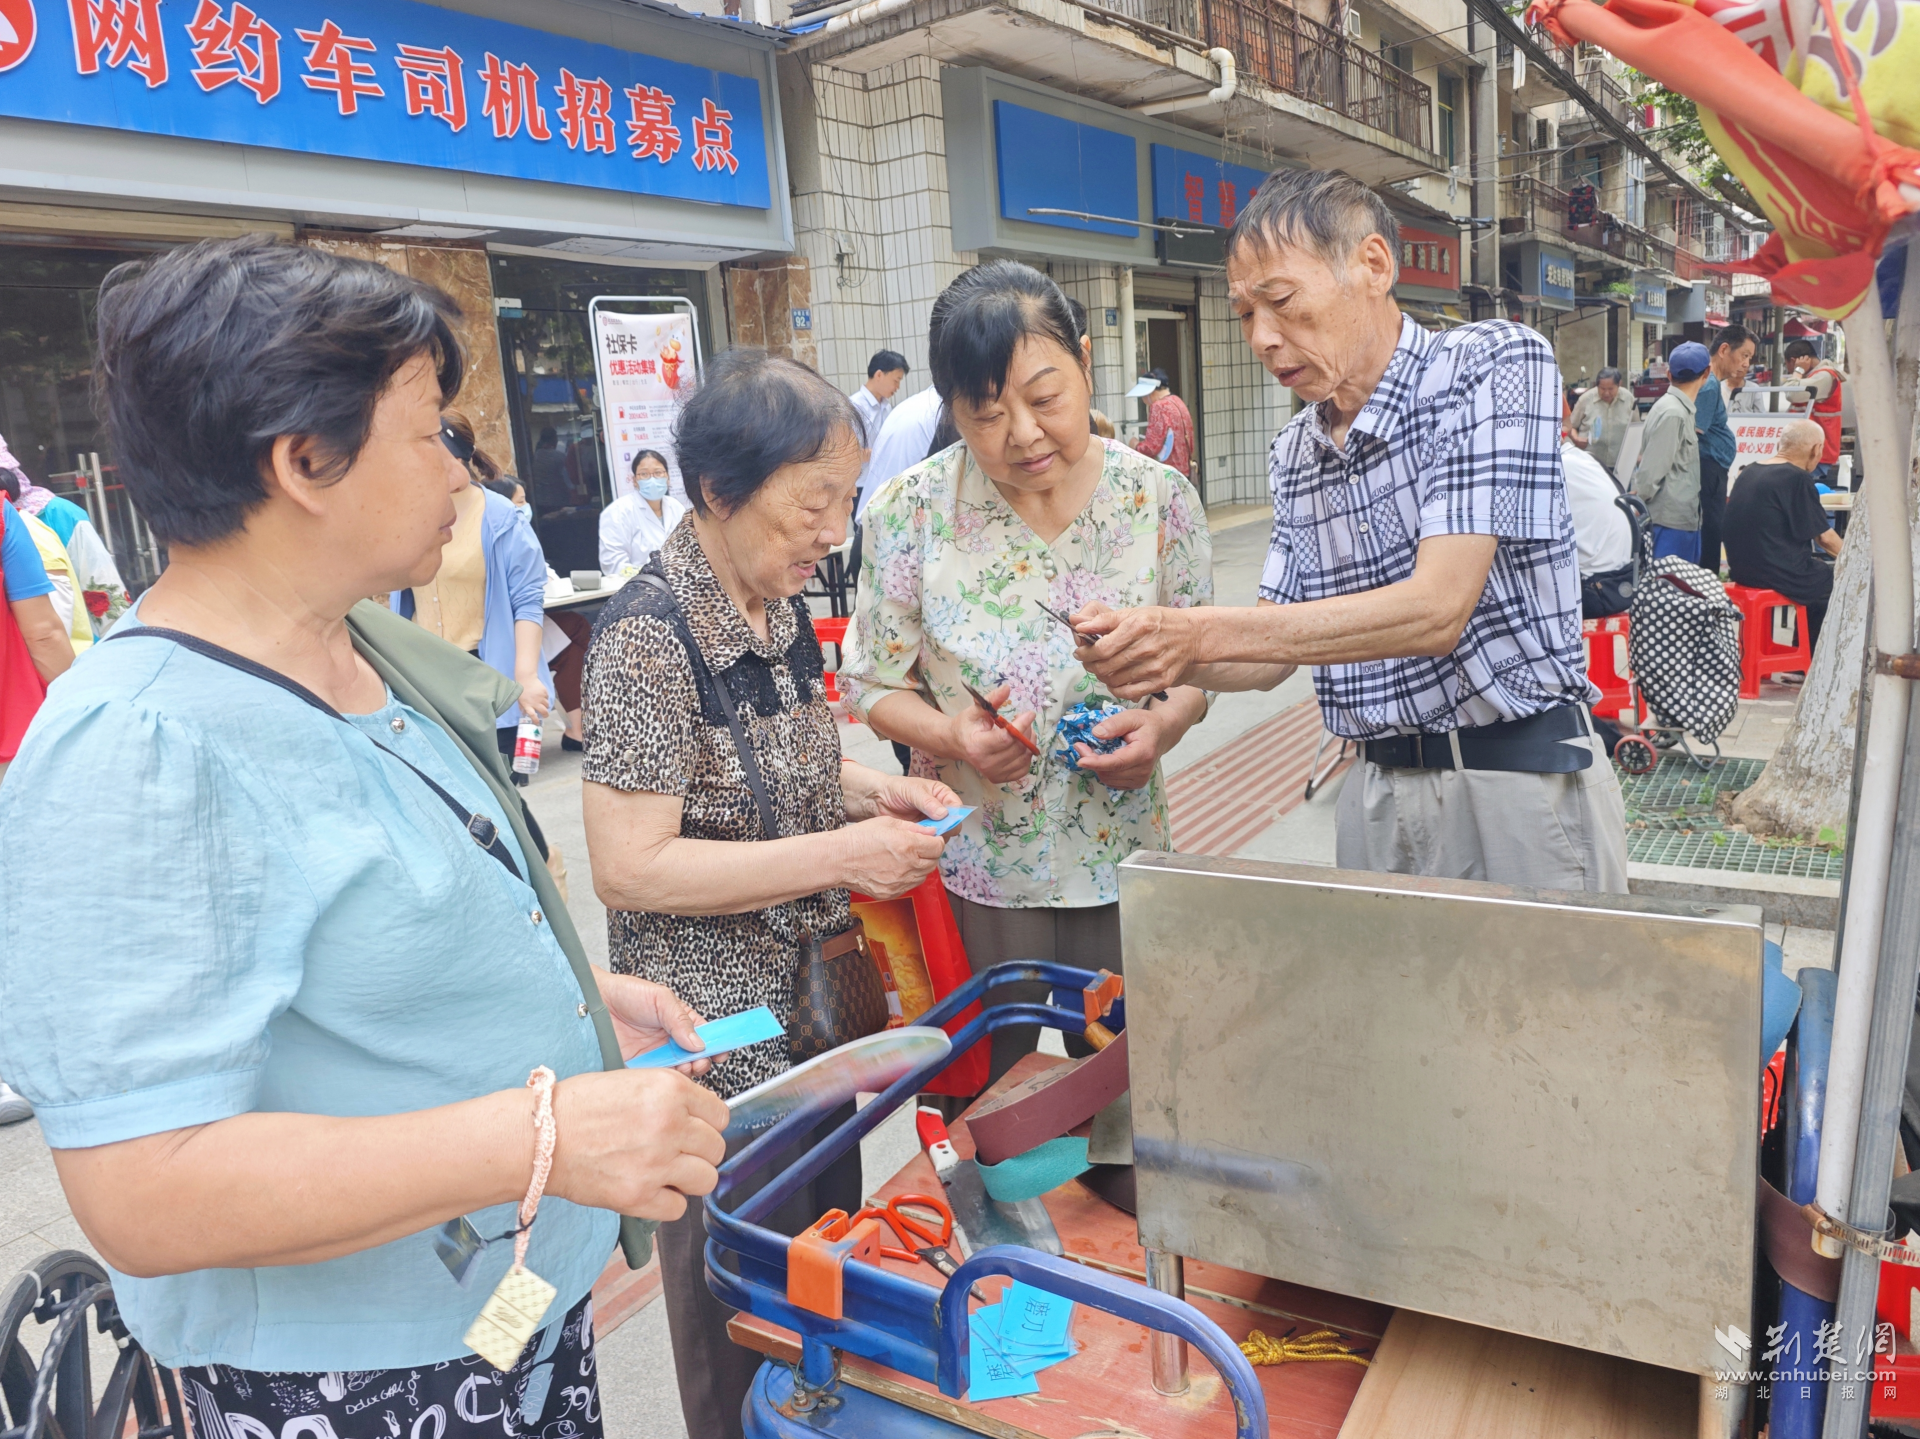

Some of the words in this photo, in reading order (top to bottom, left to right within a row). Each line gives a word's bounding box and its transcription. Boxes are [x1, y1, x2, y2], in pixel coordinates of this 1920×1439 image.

[69, 0, 740, 175] 网约车司机招募点
[1184, 170, 1258, 229] 智慧
[605, 334, 638, 355] 社保卡
[1021, 1295, 1051, 1333] 磨刀
